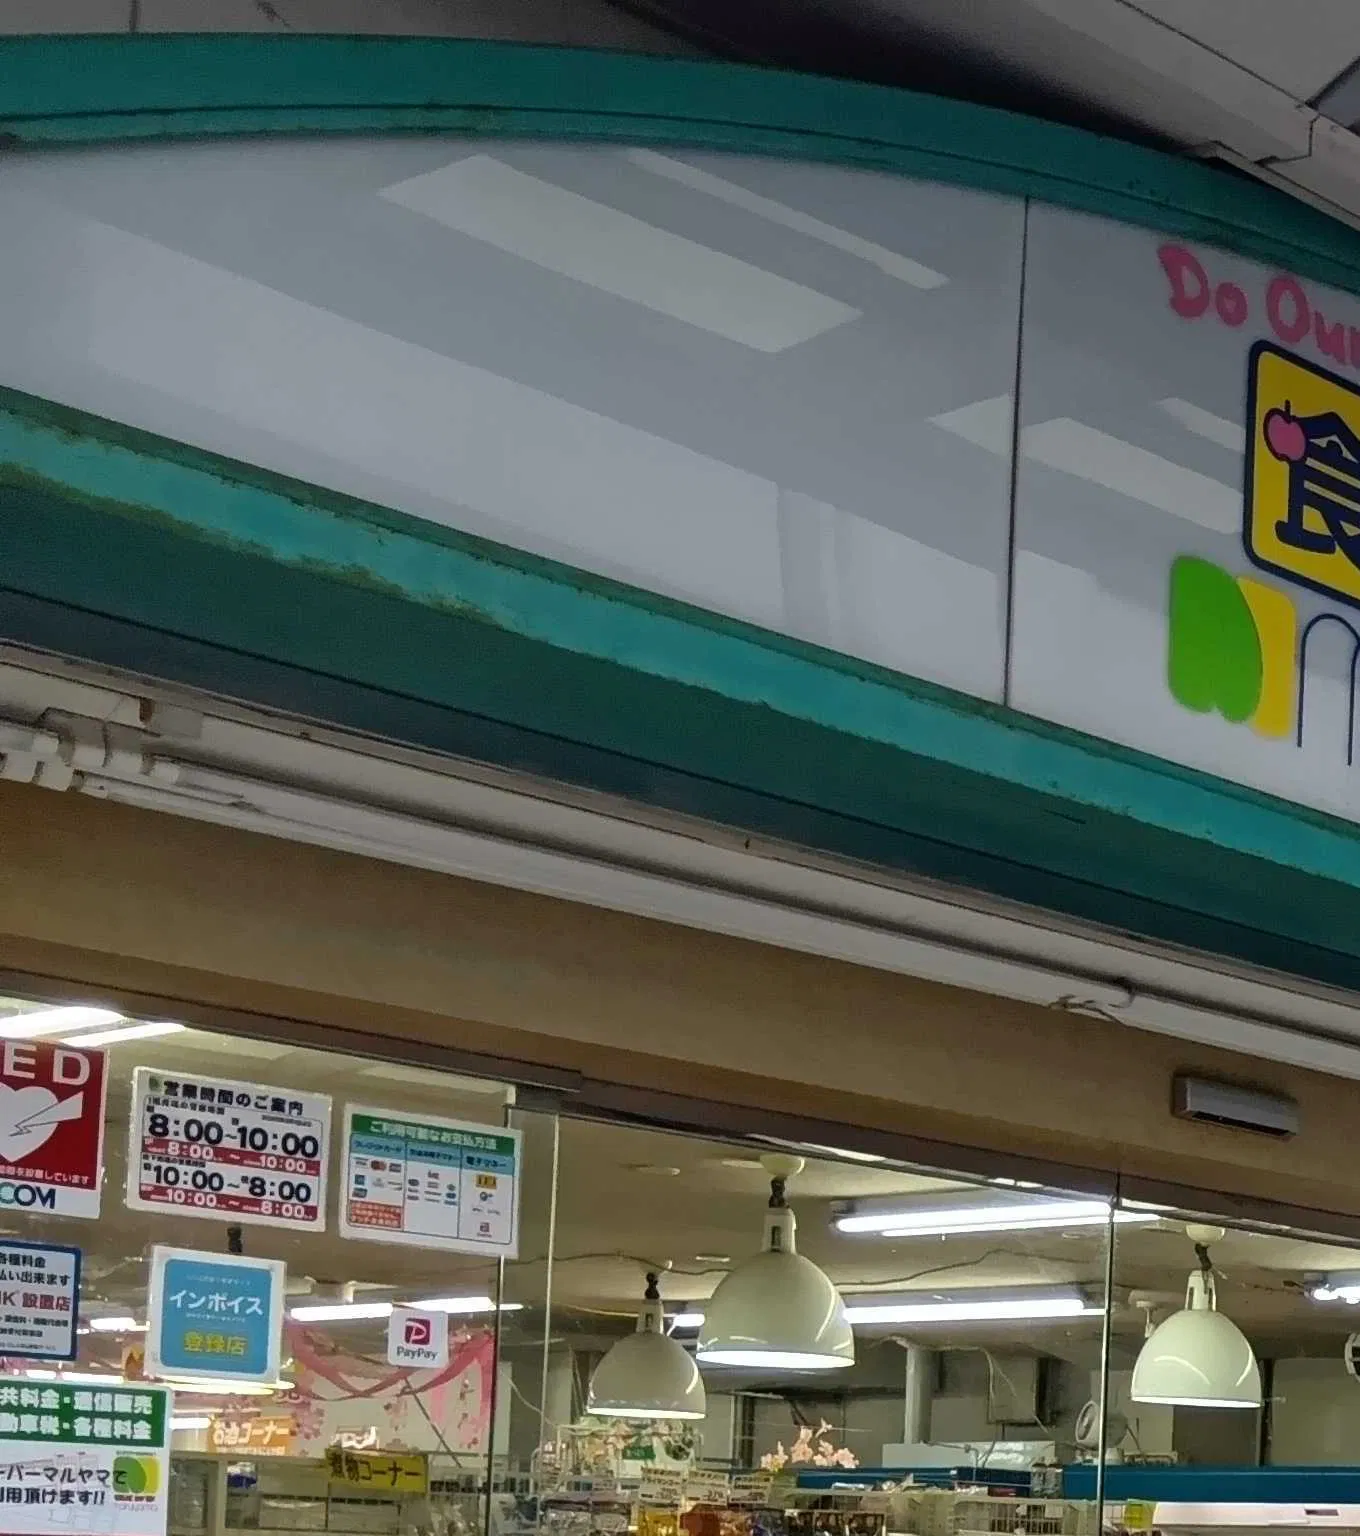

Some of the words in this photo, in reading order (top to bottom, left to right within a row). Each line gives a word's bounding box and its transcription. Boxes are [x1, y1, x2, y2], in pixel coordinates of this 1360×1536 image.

[1157, 243, 1248, 327] Do
[163, 1080, 304, 1117] 営業時間のご案内
[22, 1292, 71, 1312] 設置店
[170, 1288, 265, 1316] インボイス
[183, 1330, 247, 1357] 登録店
[396, 1346, 439, 1362] PayPay
[0, 1465, 129, 1488] パーマルヤマで
